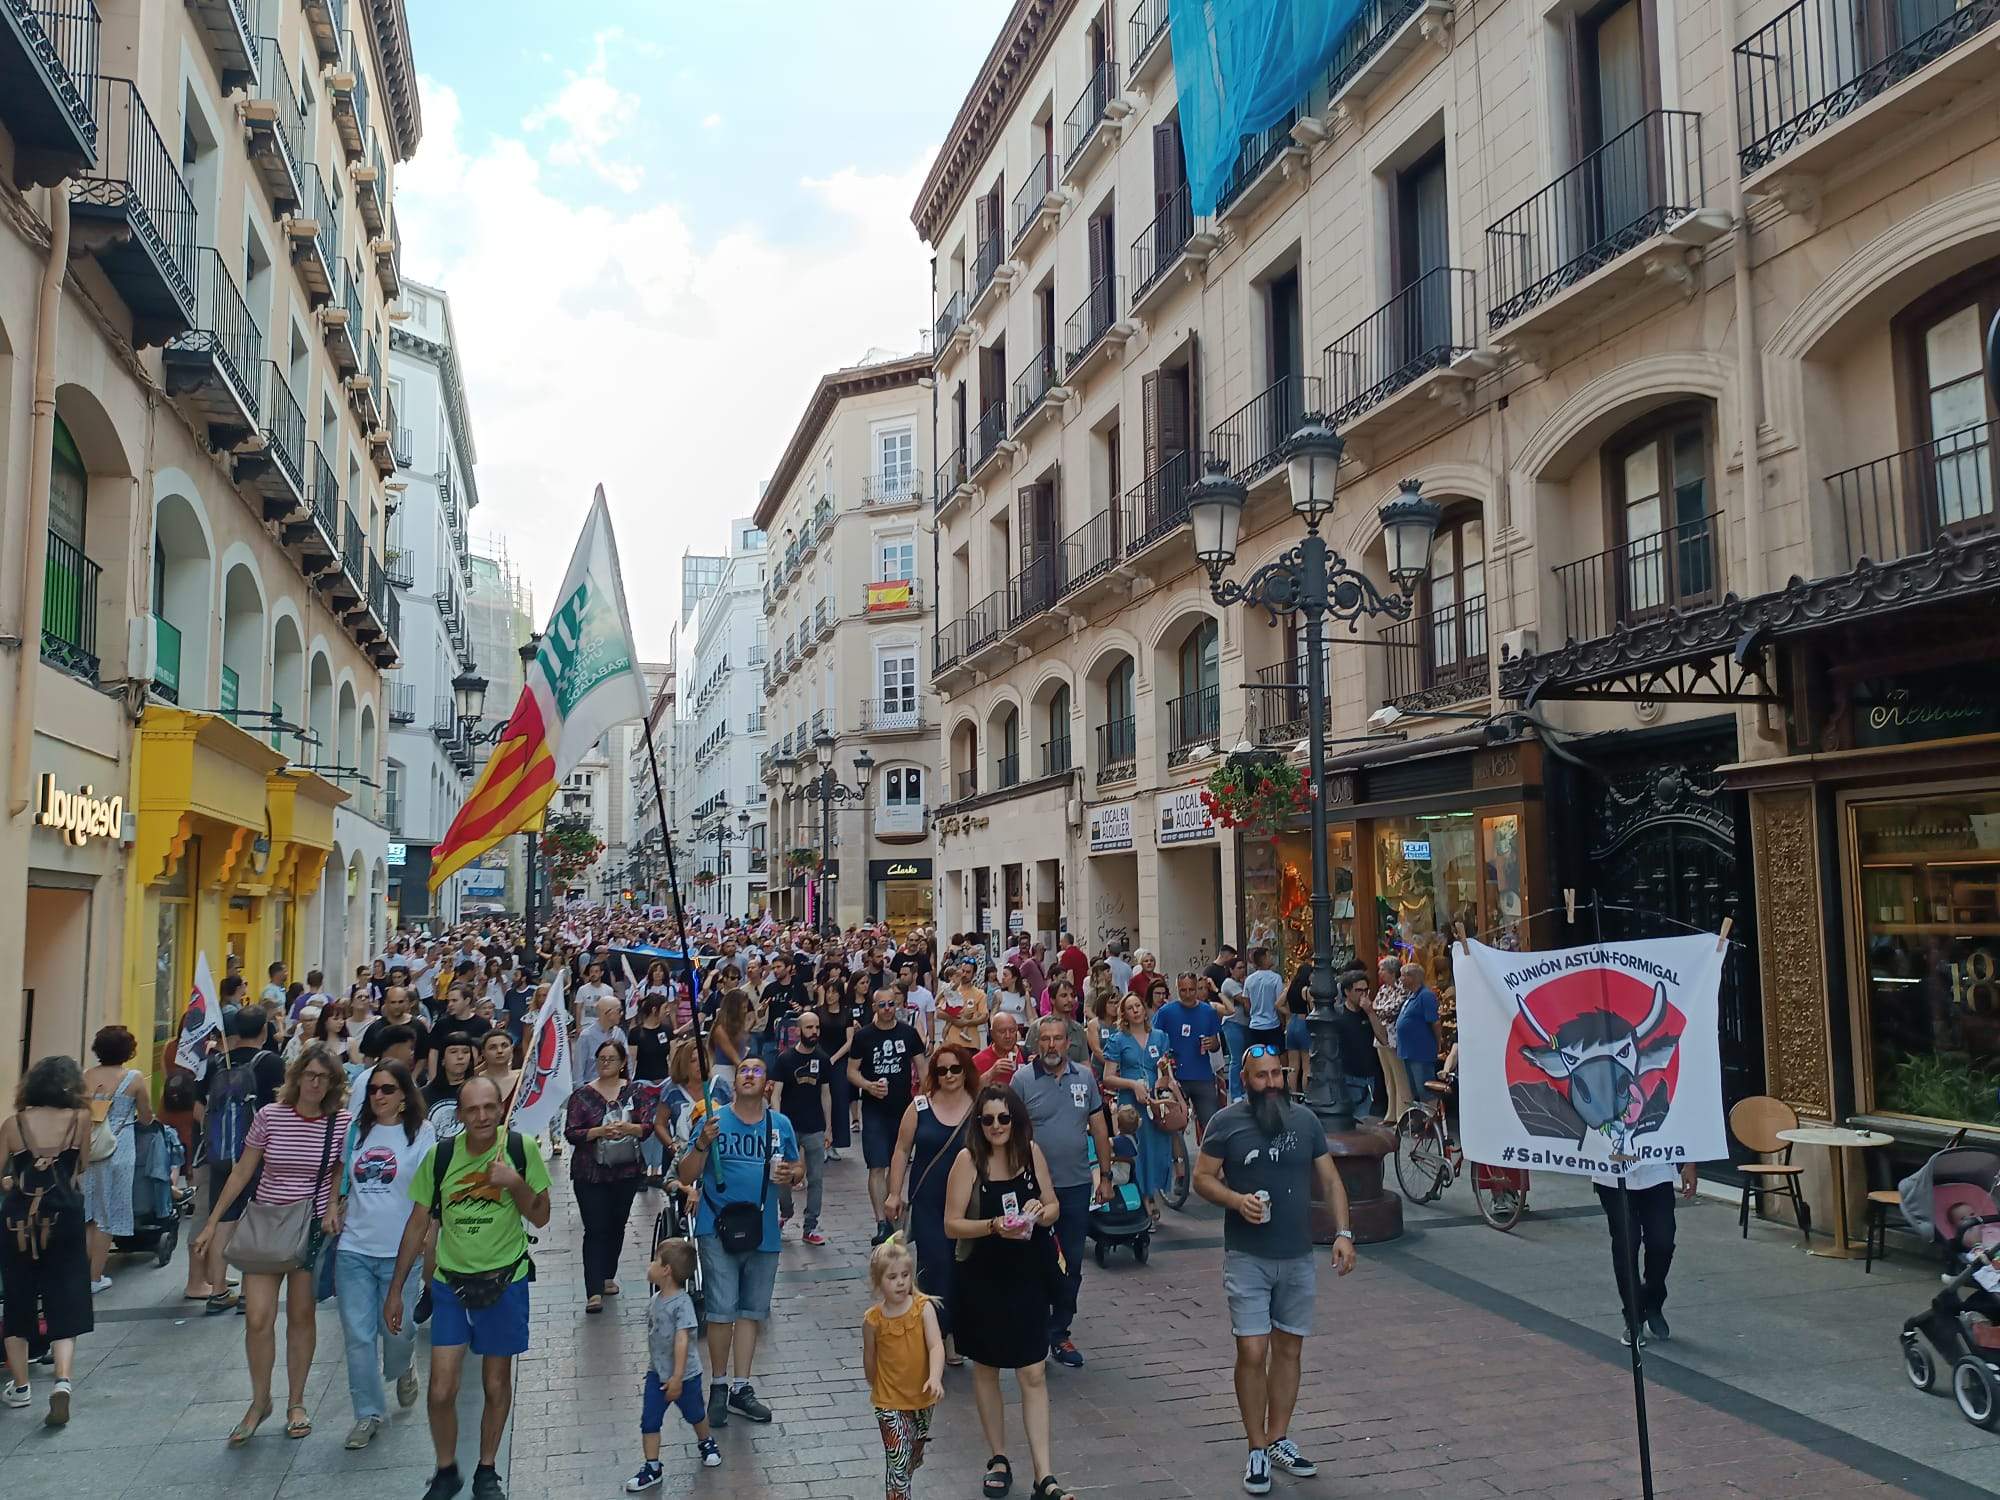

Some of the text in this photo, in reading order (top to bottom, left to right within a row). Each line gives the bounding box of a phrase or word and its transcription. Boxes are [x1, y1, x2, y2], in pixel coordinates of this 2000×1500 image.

[1176, 794, 1199, 811] LOCAL
[1102, 806, 1129, 824] LOCAL EN
[1102, 822, 1130, 839] ALQUILER
[887, 863, 918, 876] Clarks
[1504, 946, 1681, 991] NO UNIÓN ASTÚN-FORMIGAL
